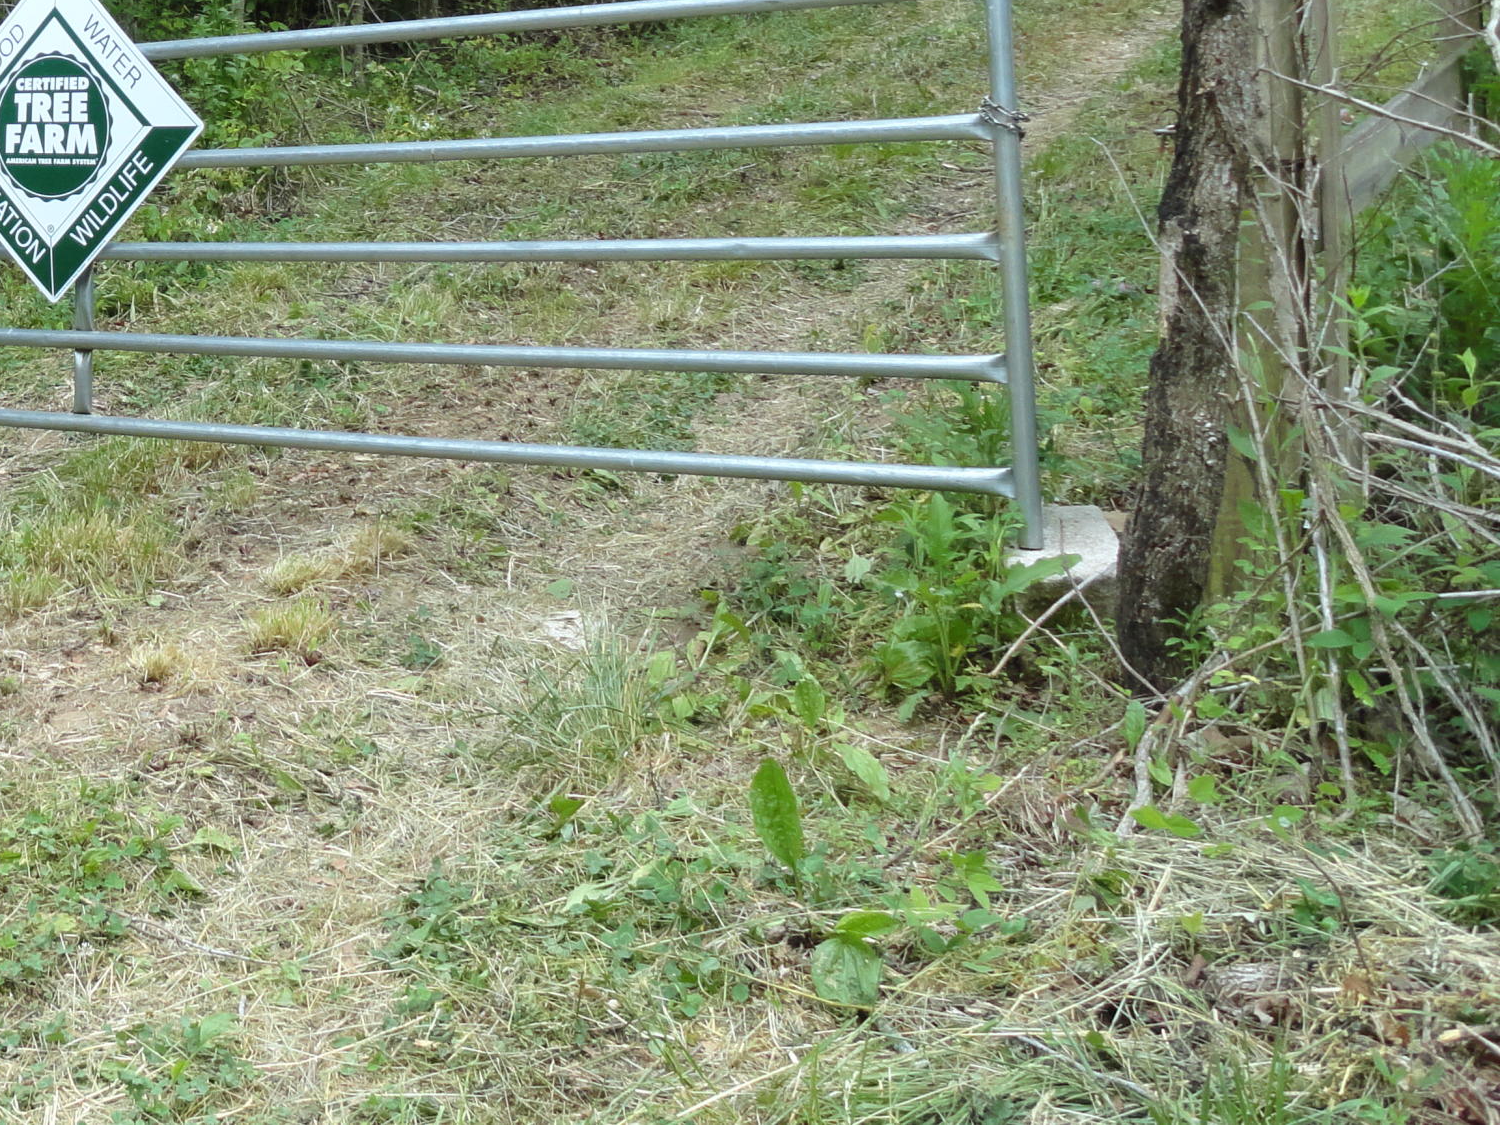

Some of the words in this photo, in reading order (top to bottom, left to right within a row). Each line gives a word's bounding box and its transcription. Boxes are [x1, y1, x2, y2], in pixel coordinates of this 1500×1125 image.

[83, 13, 142, 90] WATER
[15, 76, 90, 91] CERTIFIED
[13, 91, 89, 123] TREE
[5, 123, 98, 155] FARM
[5, 157, 37, 165] AMERICAN
[38, 157, 52, 165] TREE
[53, 157, 71, 165] FARM
[69, 150, 154, 246] WILDLIFE
